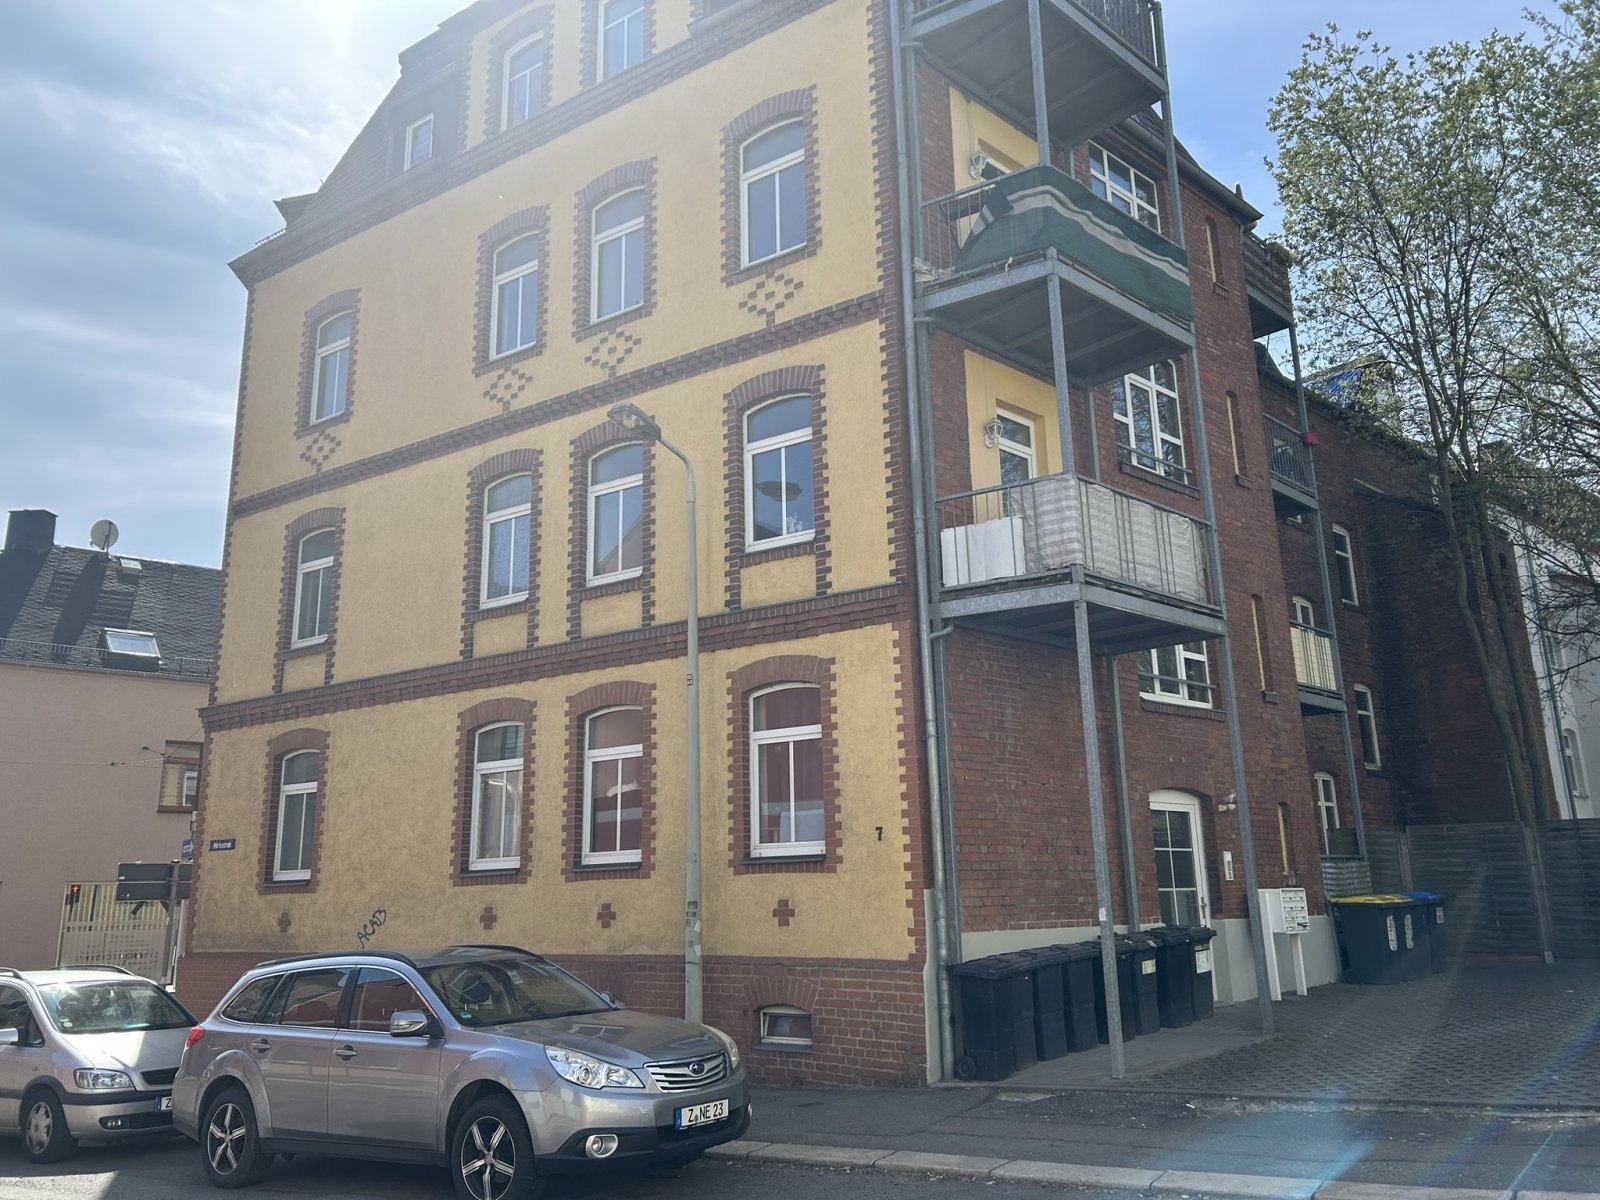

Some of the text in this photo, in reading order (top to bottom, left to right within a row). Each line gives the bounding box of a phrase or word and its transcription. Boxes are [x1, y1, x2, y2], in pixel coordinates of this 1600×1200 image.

[875, 826, 883, 841] 7
[688, 1102, 724, 1123] Z NE 23
